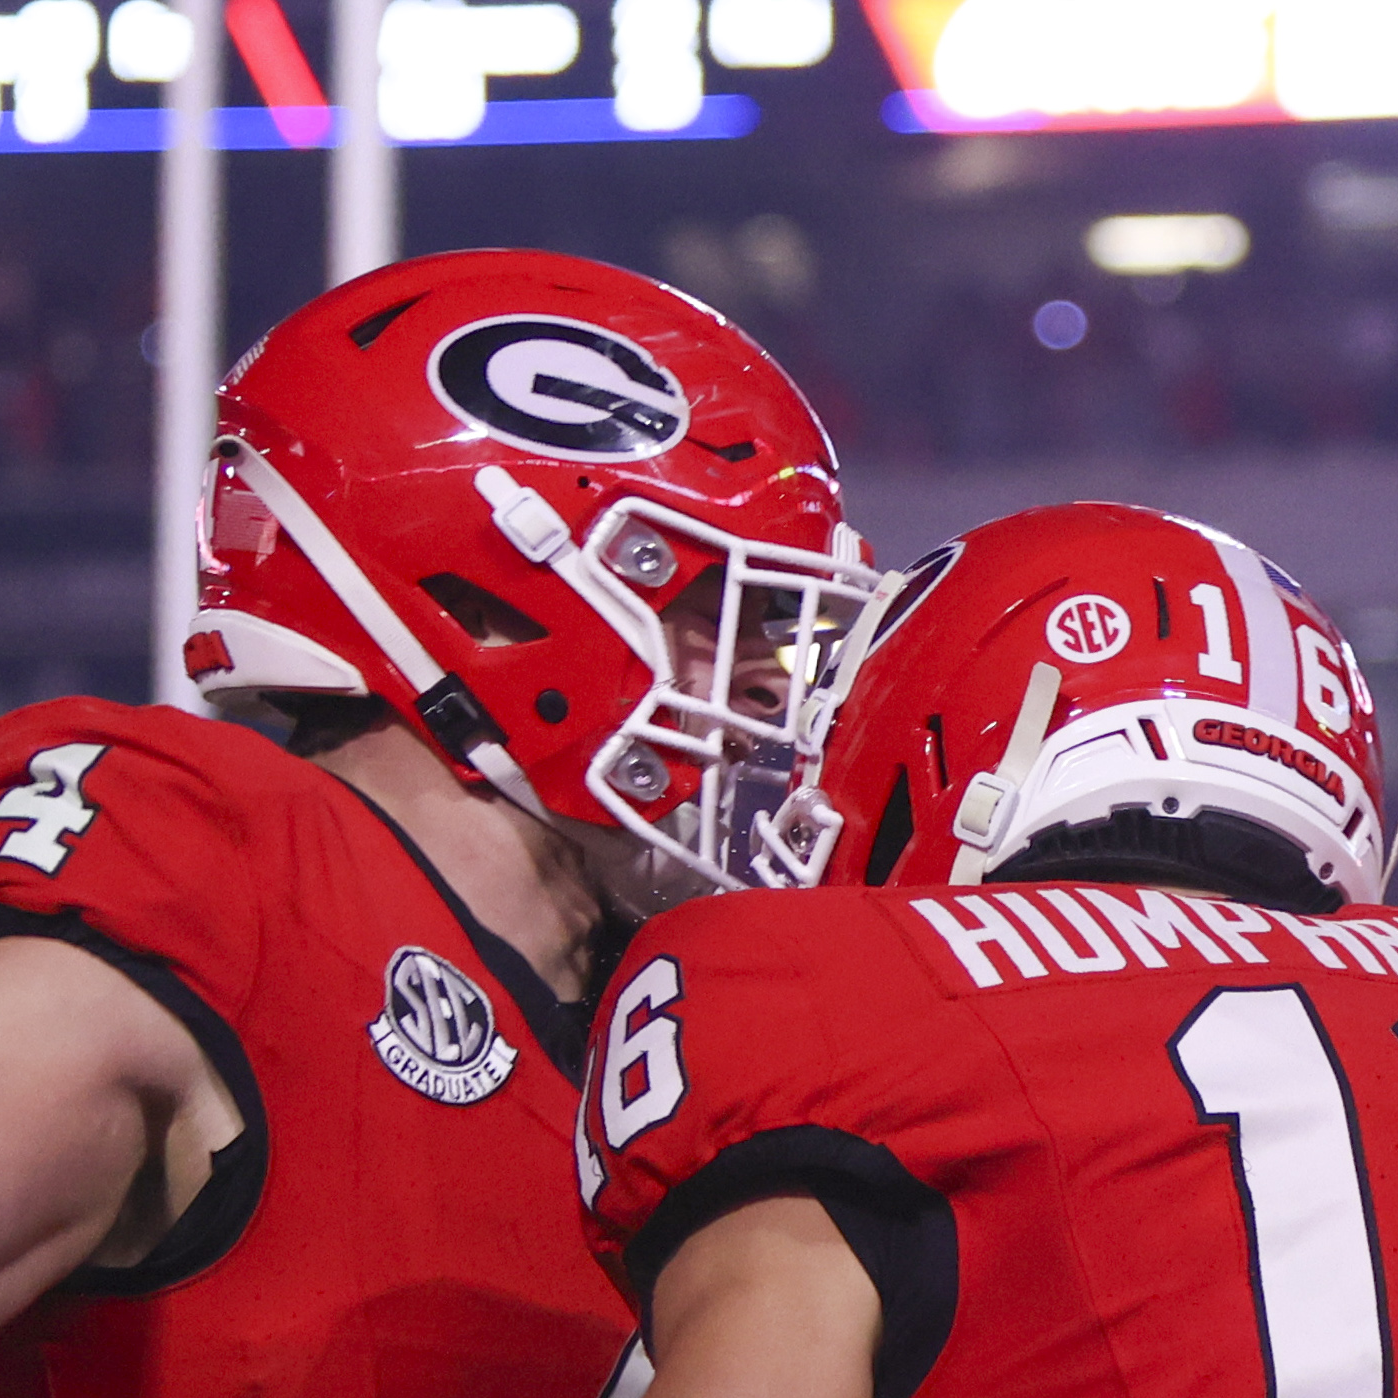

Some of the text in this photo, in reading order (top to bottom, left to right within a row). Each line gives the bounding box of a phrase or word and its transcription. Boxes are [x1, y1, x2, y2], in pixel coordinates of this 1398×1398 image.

[1056, 602, 1120, 654] SEC
[1193, 718, 1345, 807] GEORGIA
[393, 954, 483, 1062] SEC
[387, 1043, 505, 1101] GRADUATE
